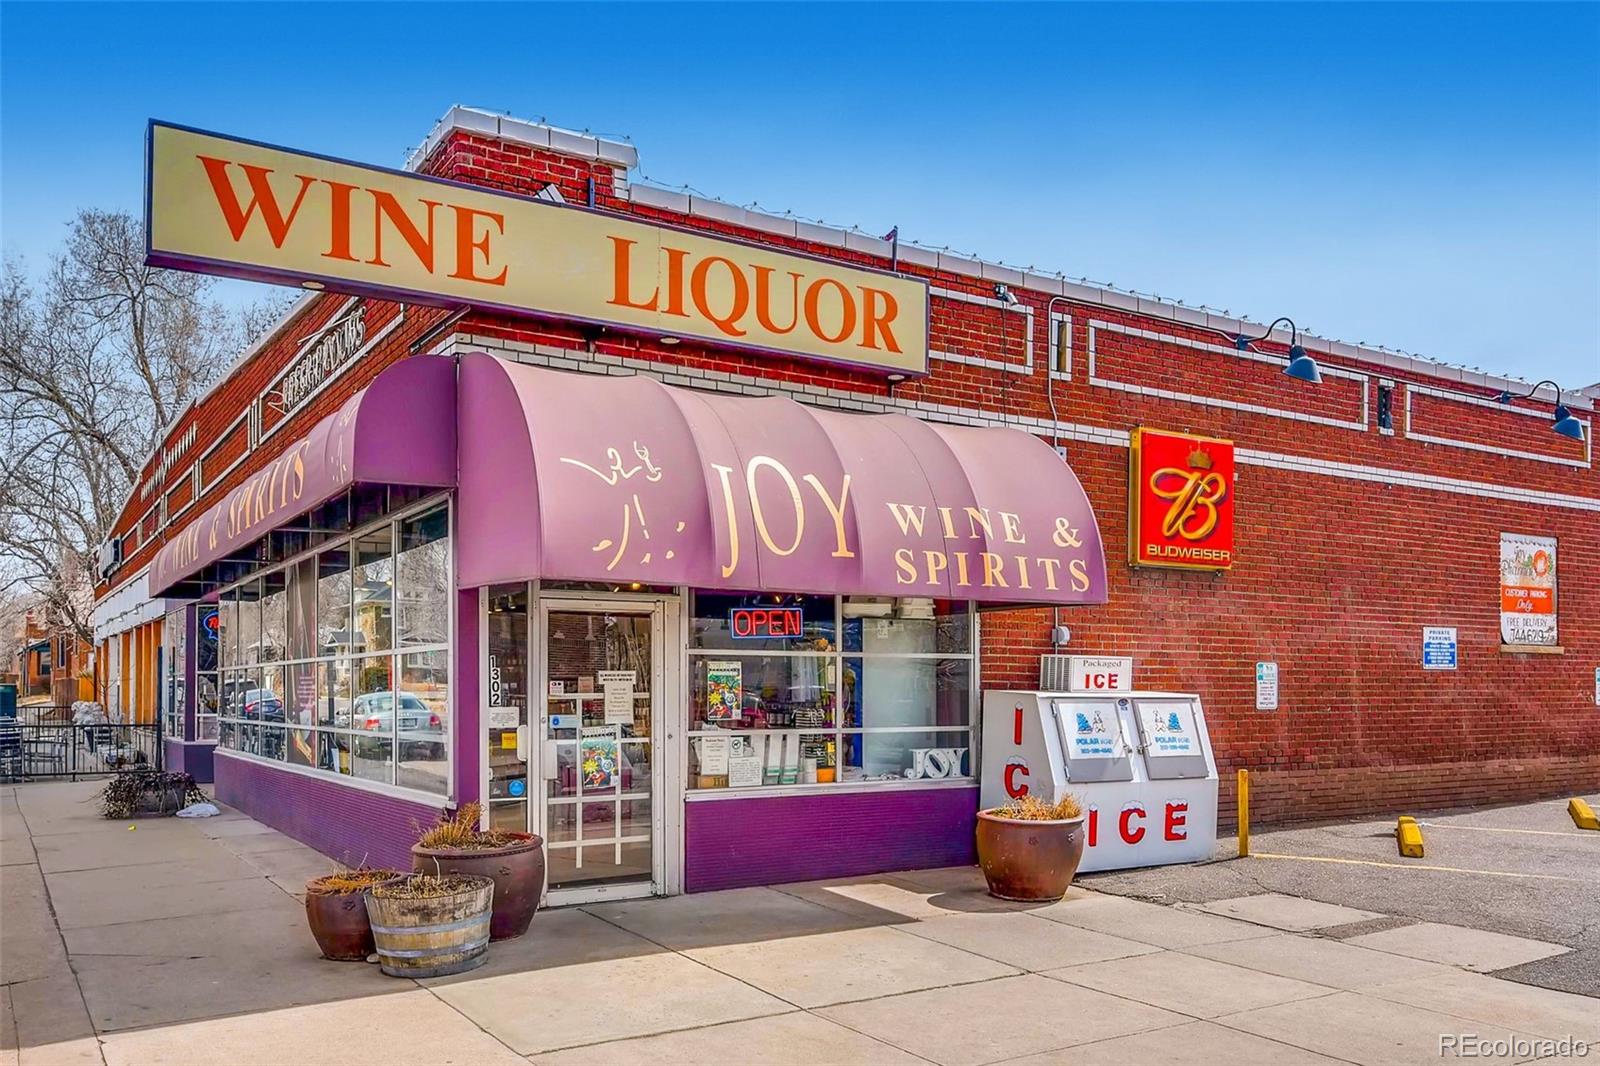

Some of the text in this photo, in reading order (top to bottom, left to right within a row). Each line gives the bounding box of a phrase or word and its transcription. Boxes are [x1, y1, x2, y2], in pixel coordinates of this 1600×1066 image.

[196, 155, 903, 354] WINE LIQUOR
[228, 439, 311, 540] SPIRITS
[711, 455, 855, 578] JOY
[886, 502, 1083, 548] WINE &
[895, 549, 1090, 593] SPIRITS
[1146, 544, 1231, 561] BUDWEISER
[735, 611, 800, 636] OPEN
[1506, 616, 1547, 627] FREE DELIVERY
[490, 656, 500, 705] 1302
[1082, 660, 1122, 668] Packaged
[1085, 672, 1119, 689] ICE
[904, 747, 969, 780] JOY
[1004, 702, 1031, 800] IC
[1087, 797, 1189, 847] ICE
